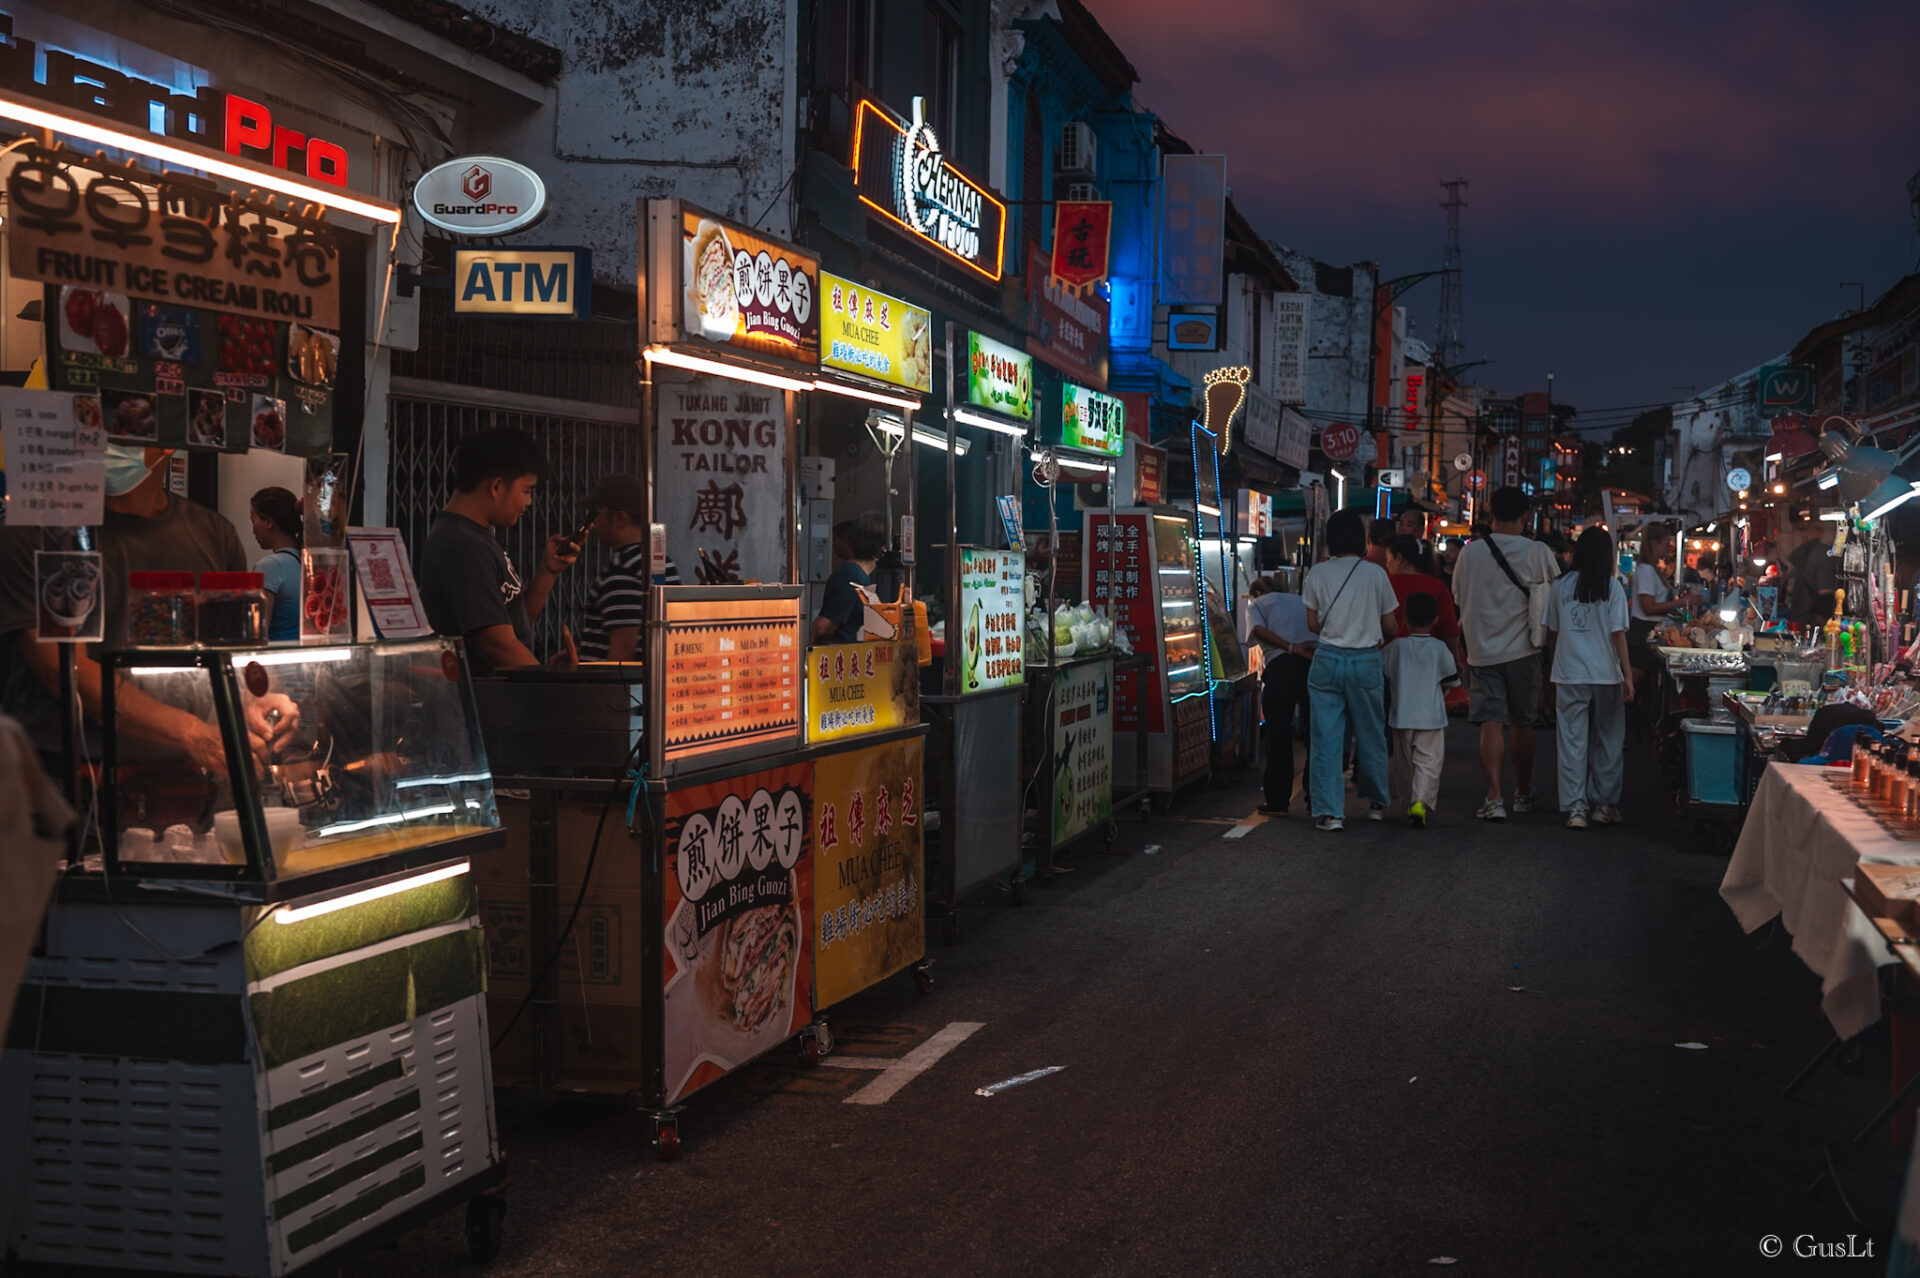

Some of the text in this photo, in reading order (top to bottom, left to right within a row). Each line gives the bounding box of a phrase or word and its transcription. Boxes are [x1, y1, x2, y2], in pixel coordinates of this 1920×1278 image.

[916, 149, 982, 230] CHERNAN
[434, 203, 518, 215] GuardPro
[38, 248, 118, 289] FRUIT
[126, 264, 169, 296] ICE
[174, 273, 258, 310] CREAM
[462, 263, 568, 302] ATM
[736, 257, 810, 315] 煎饼果子
[745, 310, 802, 339] Jian Bing Guozi
[842, 320, 880, 346] MUA CHEE
[1774, 379, 1799, 395] W
[678, 395, 770, 414] TUKANG JAHIT
[671, 418, 776, 448] KONG
[682, 453, 768, 473] TAILOR
[1126, 524, 1139, 599] 全手工制作
[829, 684, 864, 704] MUA CHEE
[682, 803, 799, 892] 煎饼果子
[838, 841, 902, 890] MUA CHEE
[700, 875, 788, 928] Jian Bing Guozi
